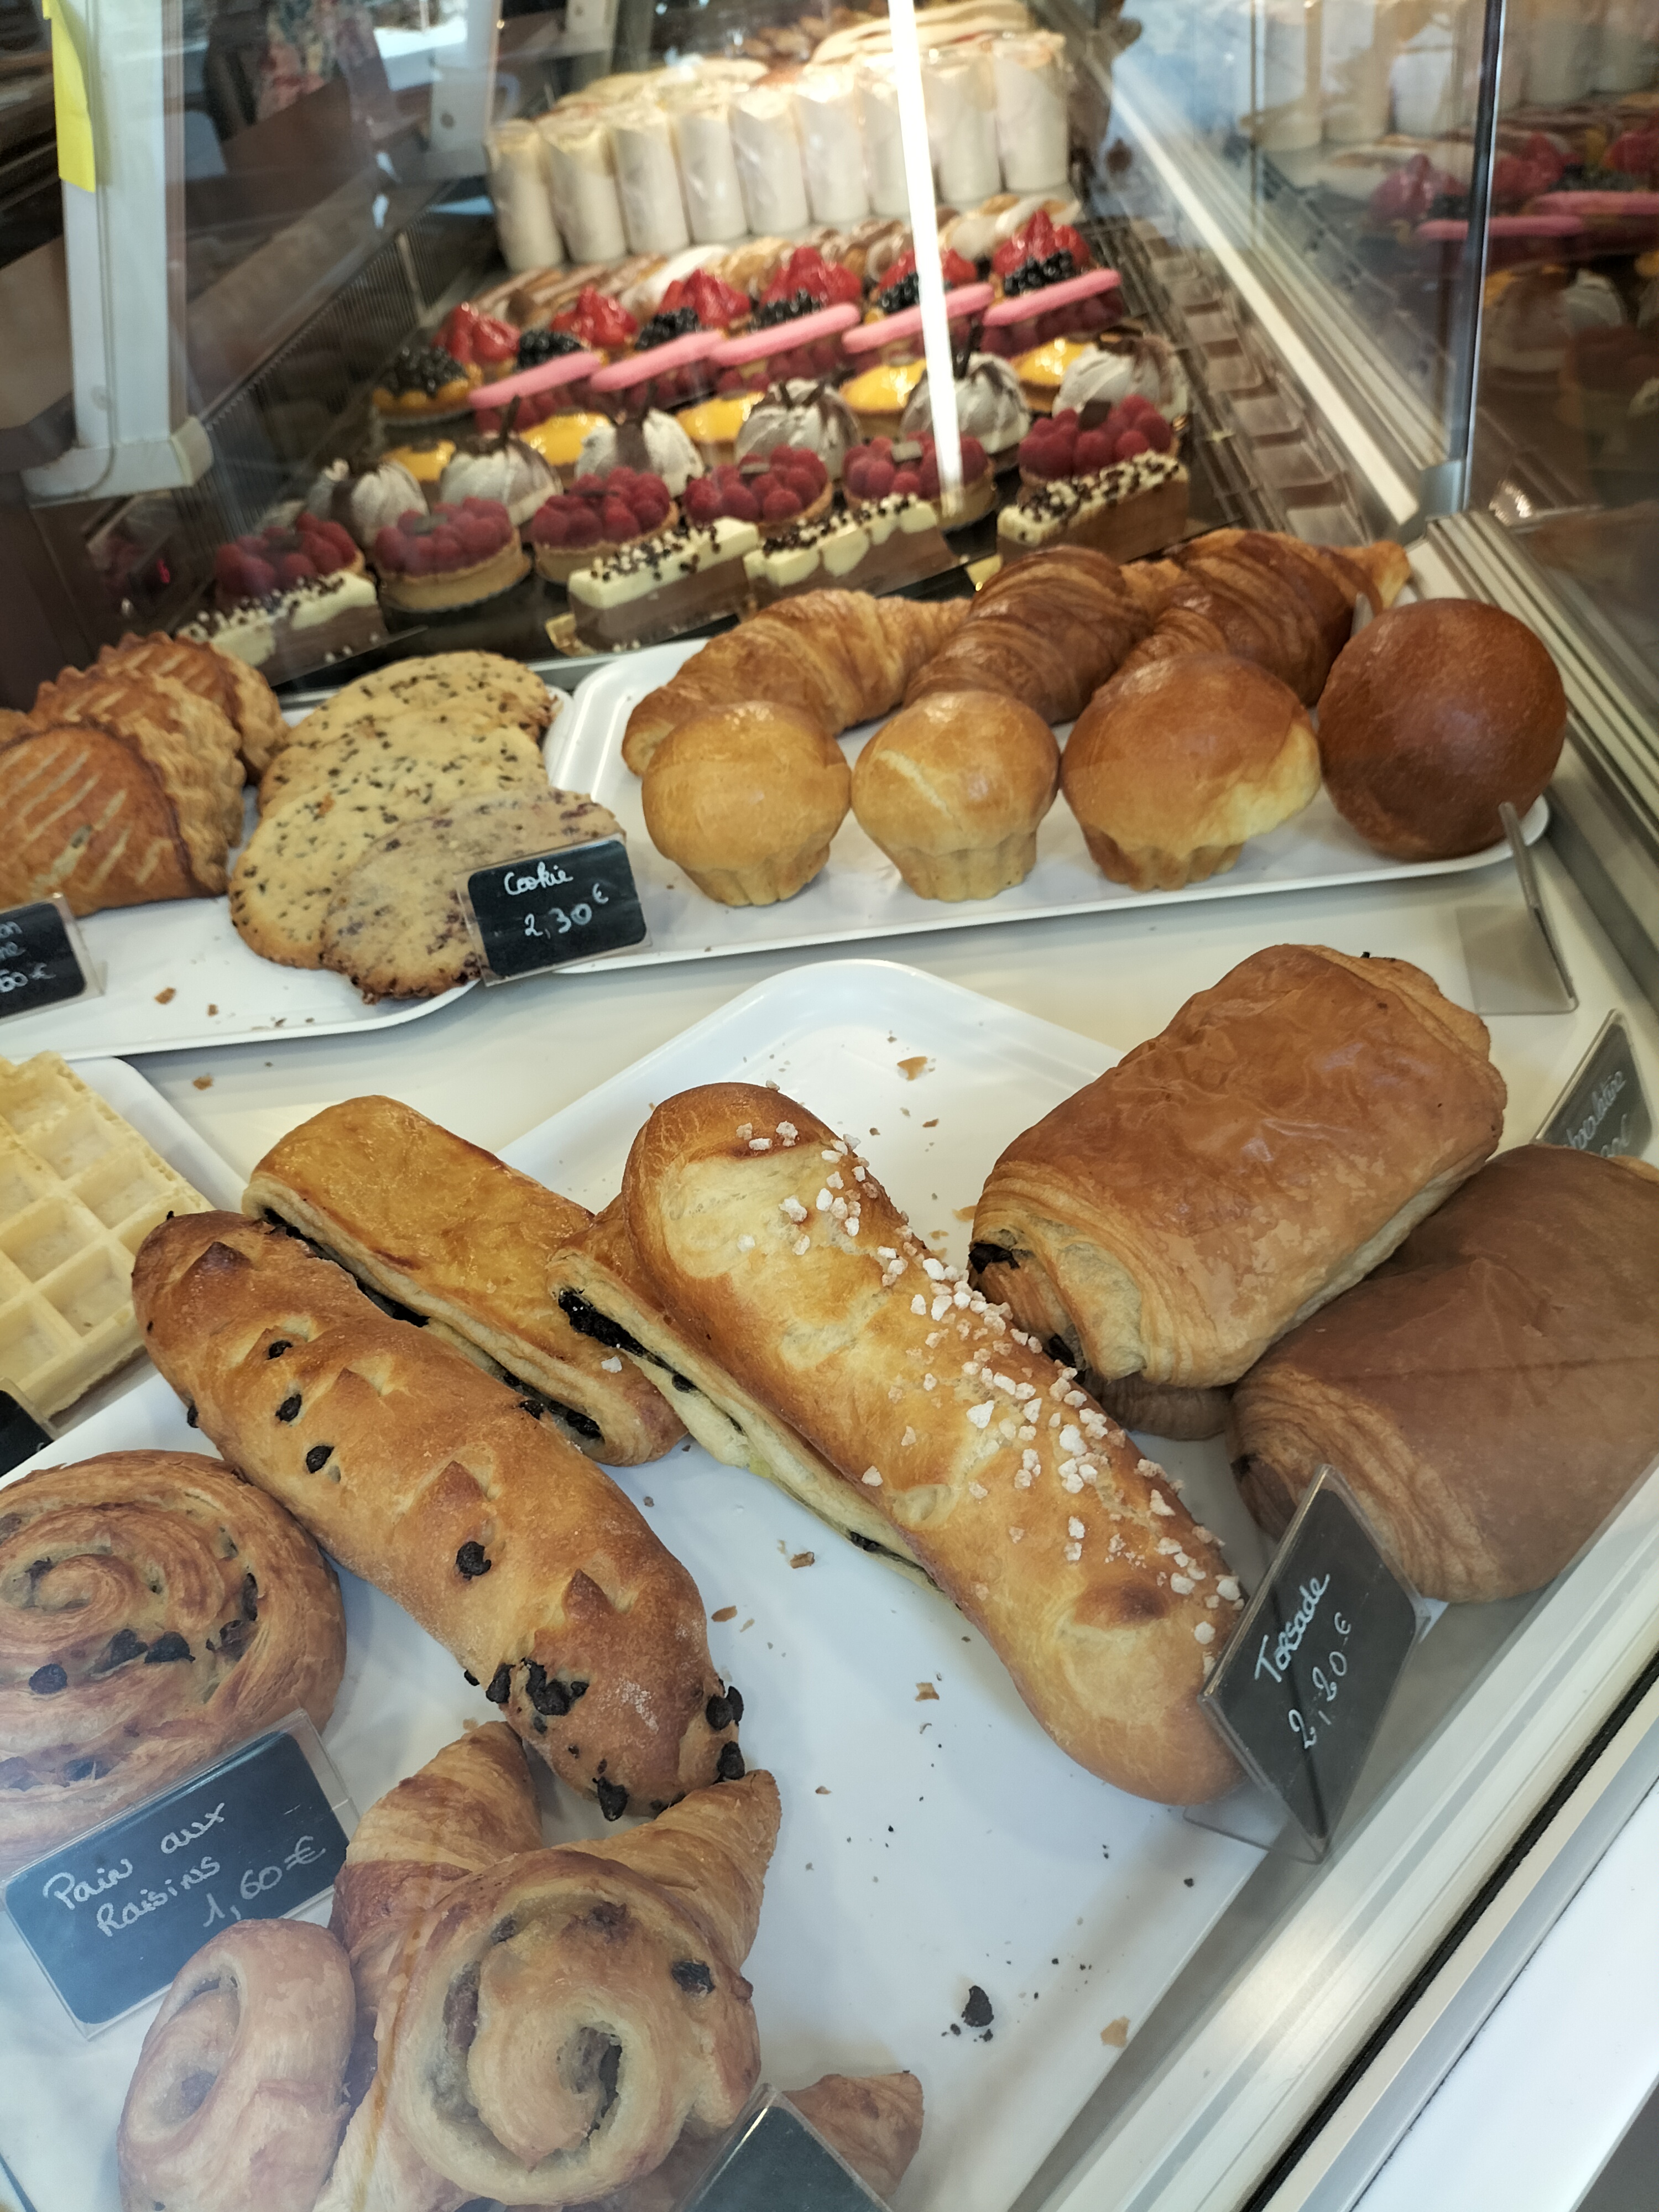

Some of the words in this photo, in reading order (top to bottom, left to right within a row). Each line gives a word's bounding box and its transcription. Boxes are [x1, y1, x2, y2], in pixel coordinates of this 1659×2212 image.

[504, 861, 573, 895] Cookie
[1254, 1573, 1331, 1683] Torsade
[43, 1859, 133, 1910] Pain
[160, 1802, 225, 1854] aux
[96, 1856, 221, 1937] Raisins
